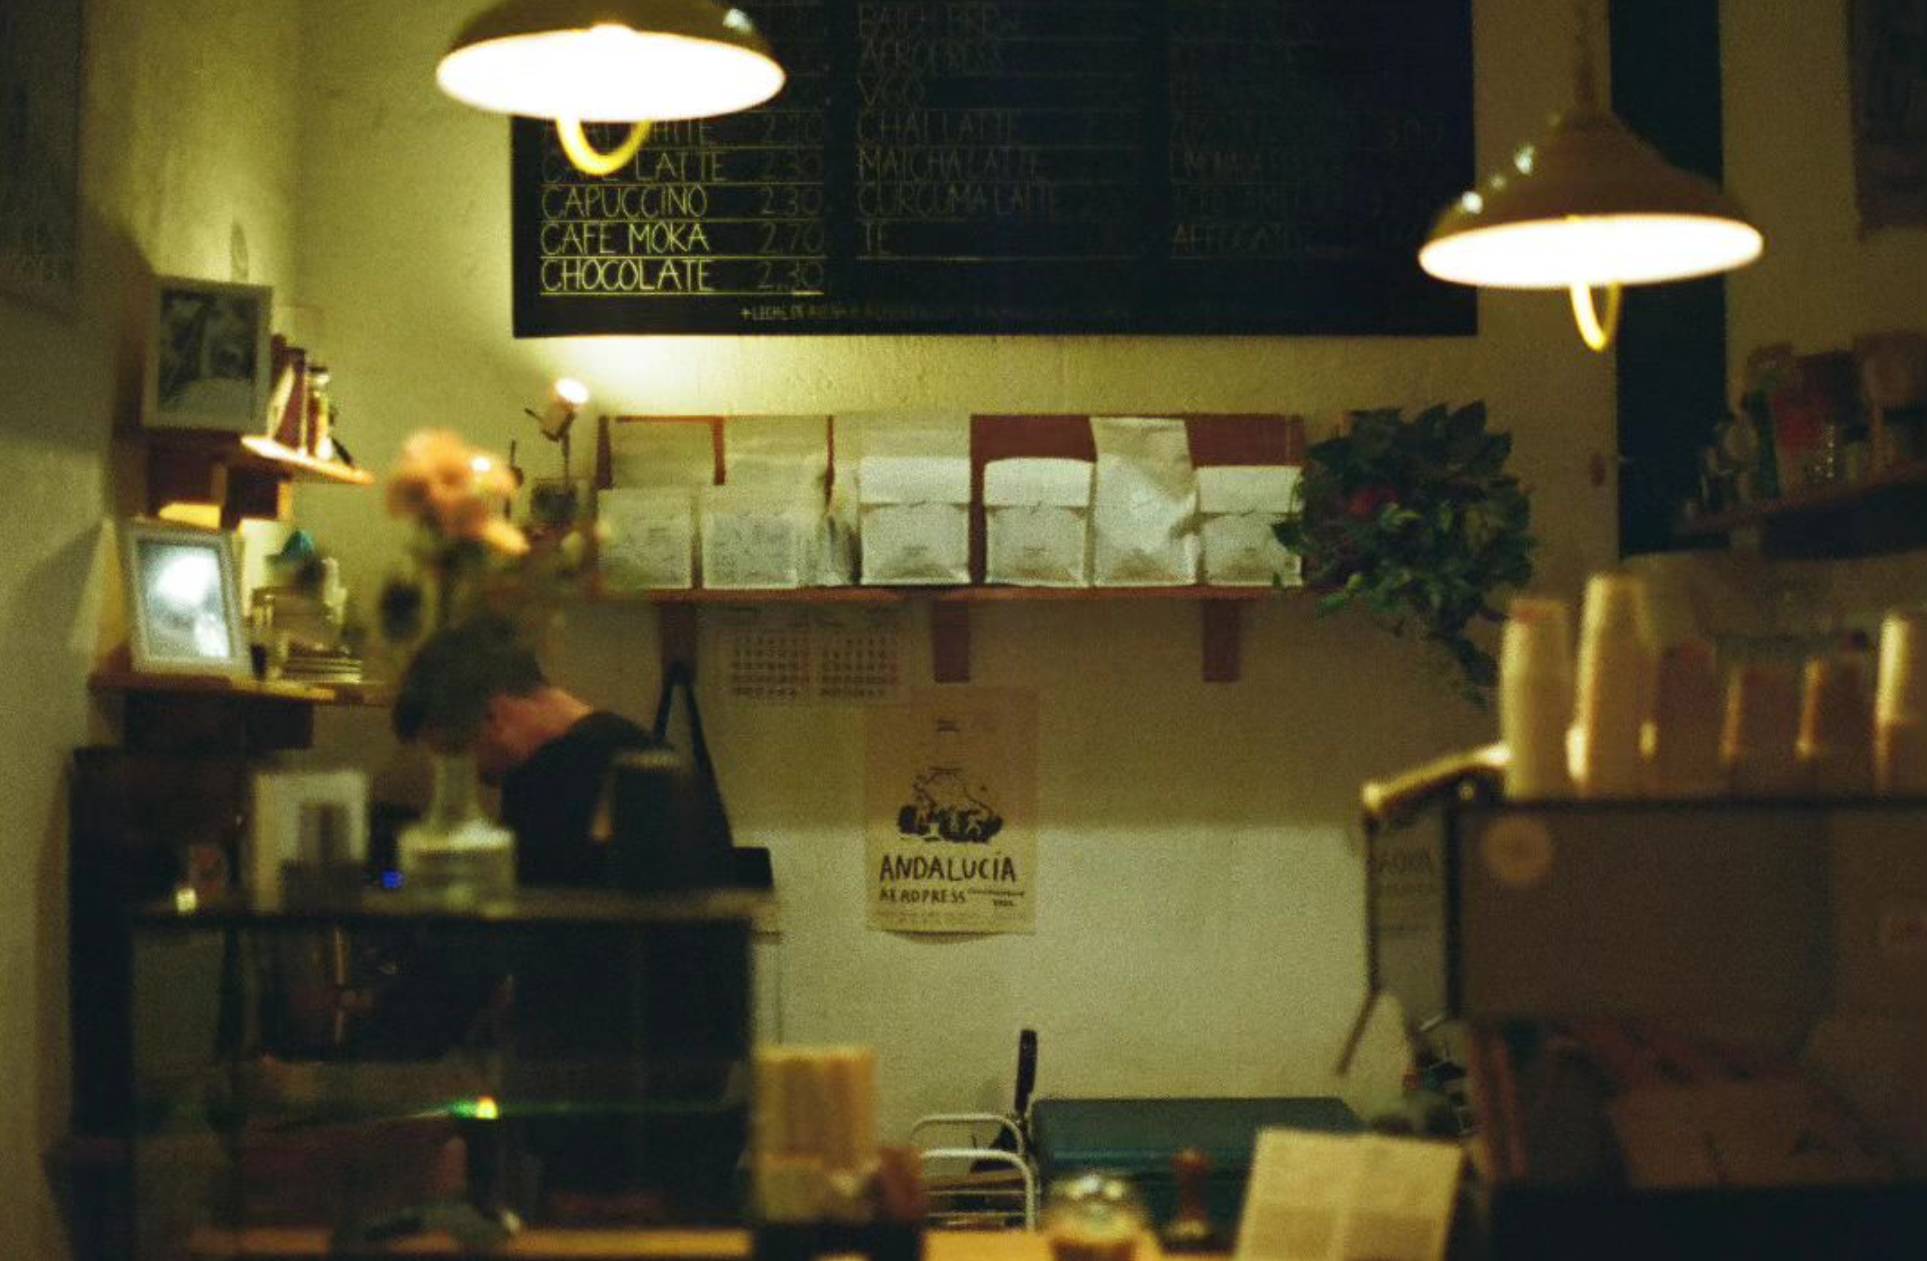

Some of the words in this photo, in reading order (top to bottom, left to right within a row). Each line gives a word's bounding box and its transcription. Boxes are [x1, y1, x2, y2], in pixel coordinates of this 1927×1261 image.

[635, 151, 727, 182] LATTE
[541, 184, 708, 219] CAPUCCINO
[760, 187, 822, 216] 2.30
[540, 222, 616, 255] CAFE
[628, 222, 711, 255] MOKA
[760, 222, 824, 254] 2.70
[540, 258, 716, 292] CHOCOLATE
[757, 260, 824, 291] 2.30
[879, 888, 966, 904] AEROPRESS
